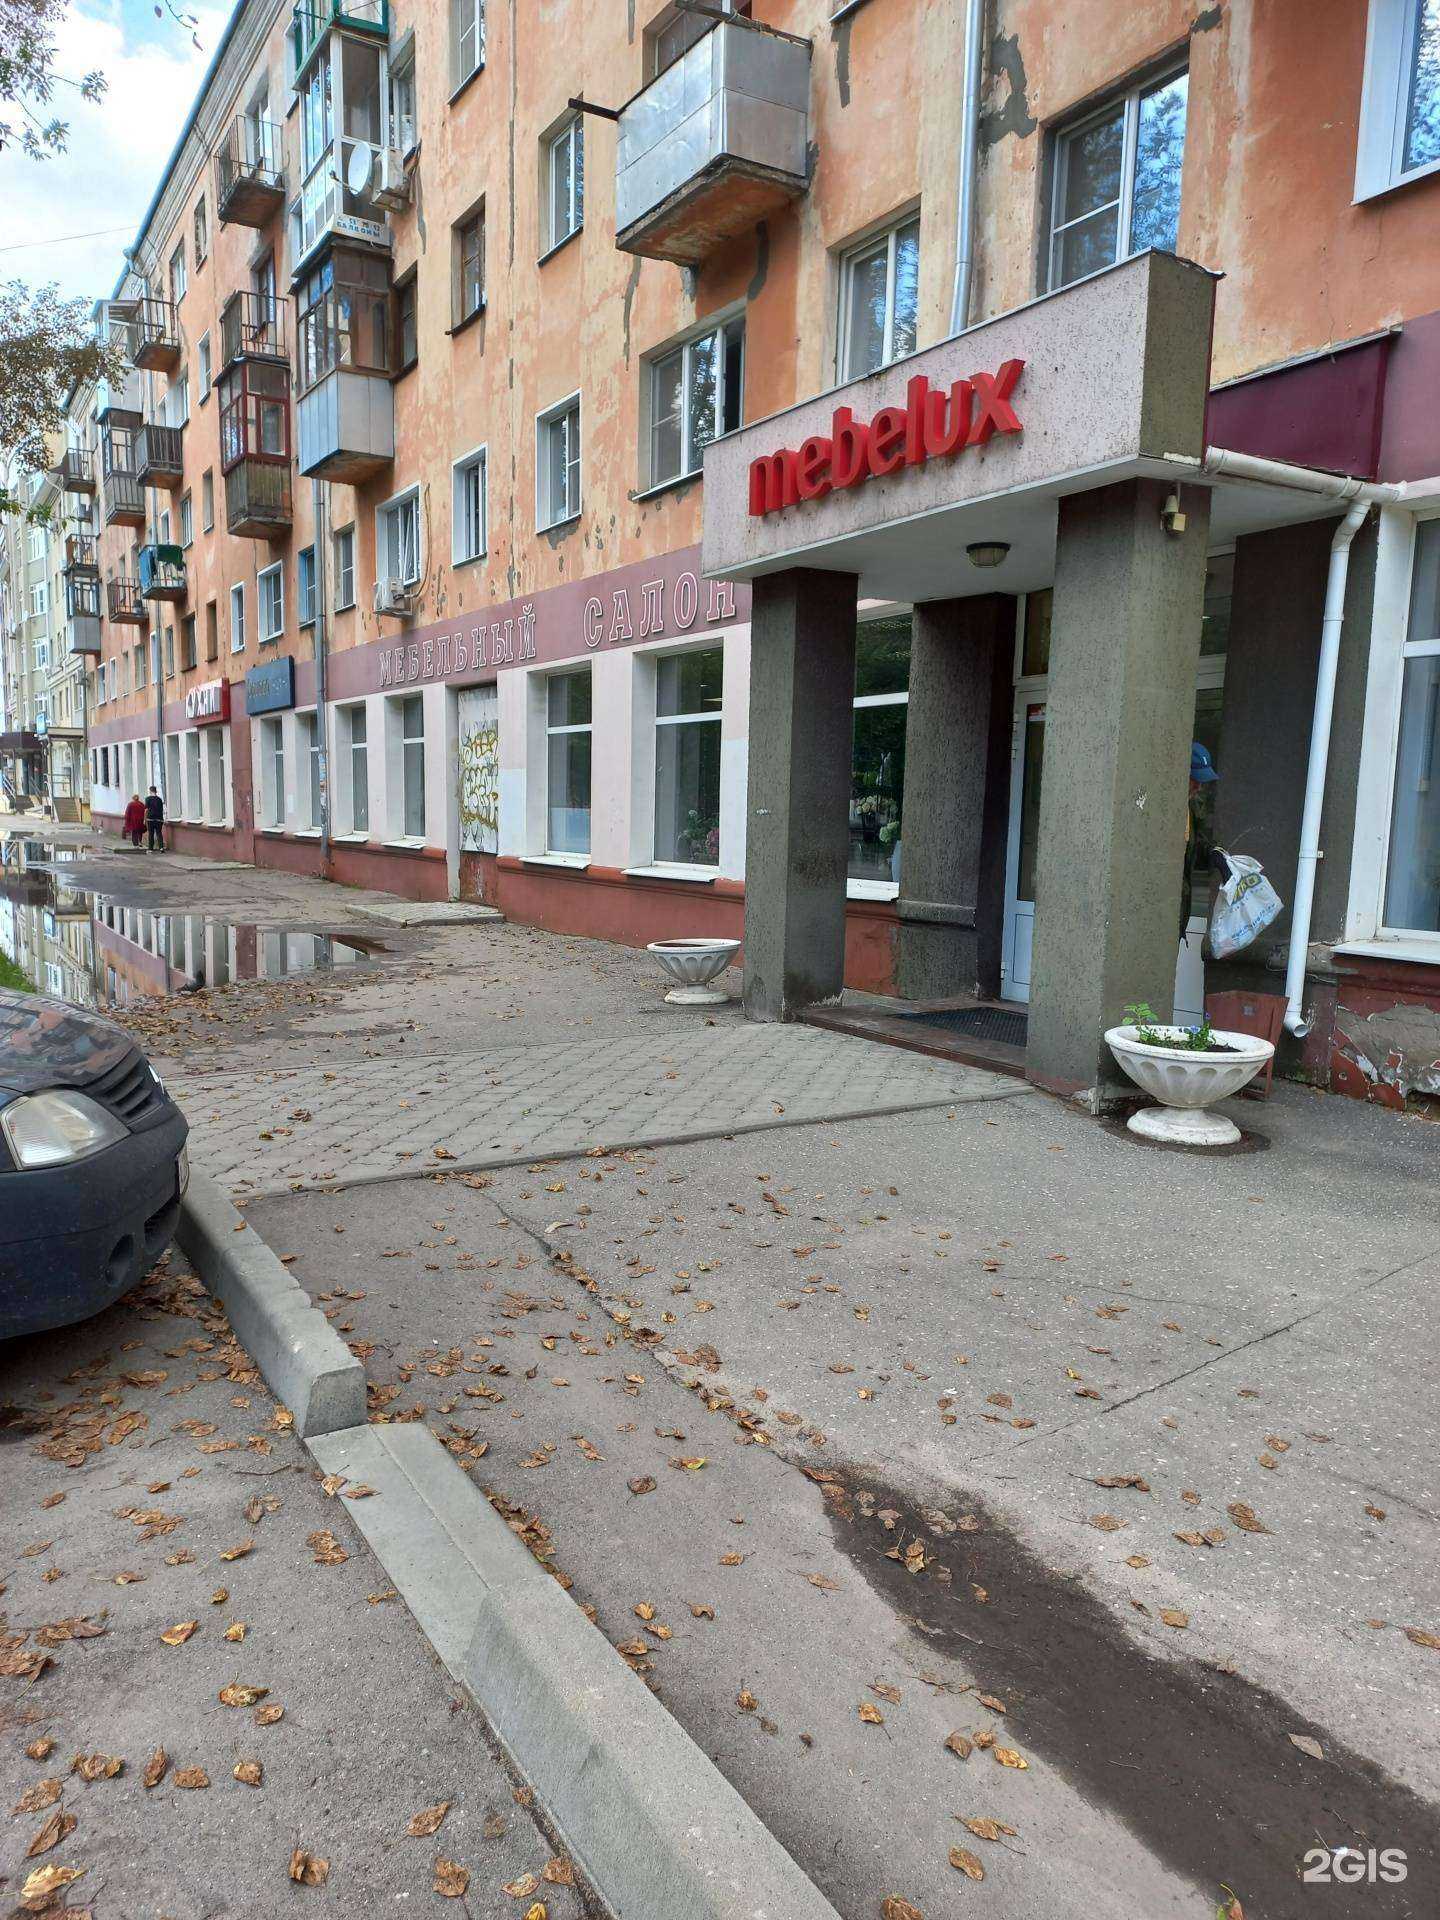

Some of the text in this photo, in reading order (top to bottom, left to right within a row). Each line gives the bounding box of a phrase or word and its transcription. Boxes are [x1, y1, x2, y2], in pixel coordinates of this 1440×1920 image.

[748, 358, 1026, 517] mebelux
[379, 572, 735, 687] МЕБЕЛЬНЫЙ САЛОН
